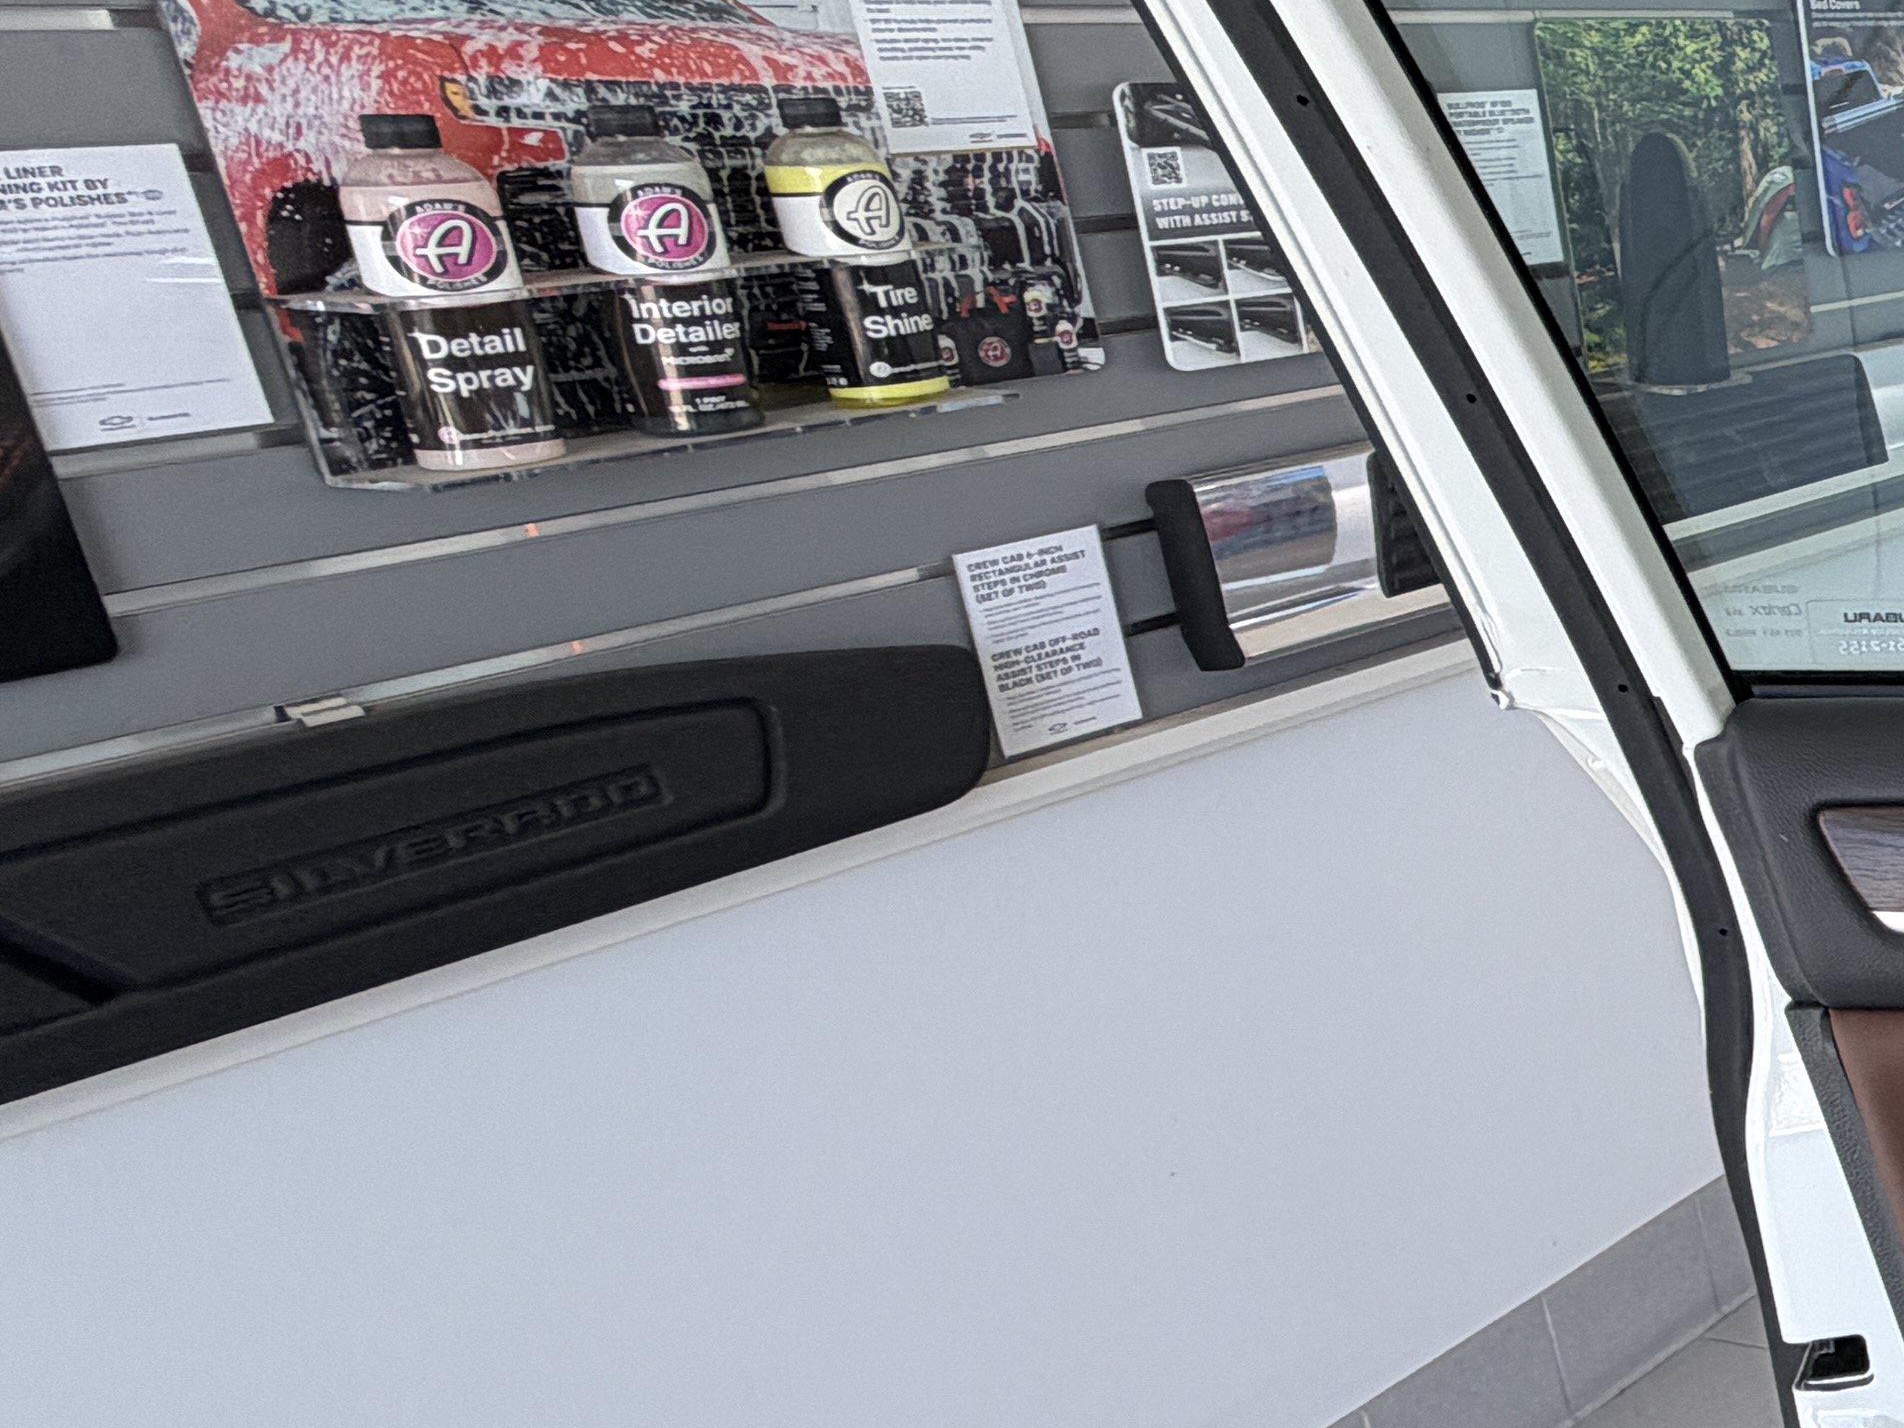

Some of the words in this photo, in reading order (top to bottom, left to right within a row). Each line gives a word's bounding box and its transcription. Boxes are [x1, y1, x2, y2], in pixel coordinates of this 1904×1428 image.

[4, 165, 64, 180] LINER
[47, 179, 79, 193] KIT
[84, 178, 111, 191] BY
[1152, 194, 1210, 212] STEP-UP
[1155, 214, 1193, 230] WITH
[1193, 211, 1238, 227] ASSIST
[1240, 210, 1254, 224] S
[629, 294, 734, 320] Interior
[872, 284, 919, 309] Tire
[632, 320, 741, 346] Detailer
[863, 312, 935, 340] Shine
[416, 326, 528, 360] Detail
[426, 364, 536, 399] Spray
[967, 558, 1000, 573] CREW
[1001, 553, 1024, 566] CAB
[969, 560, 1048, 583] RECTANGULAR
[1050, 549, 1087, 565] ASSIST
[972, 578, 1008, 593] STEPS
[1022, 565, 1069, 583] CHROME
[975, 591, 1001, 605] (SET
[1001, 586, 1017, 598] OF
[991, 647, 1024, 662] CREW
[1024, 640, 1047, 654] CAB
[1049, 627, 1101, 648] OFF-ROAD
[993, 642, 1087, 672] HIGH-CLEARANCE
[996, 667, 1036, 682] ASSIST
[1035, 658, 1070, 674] STEPS
[998, 678, 1035, 693] BLACK
[208, 772, 661, 919] SILVERADO
